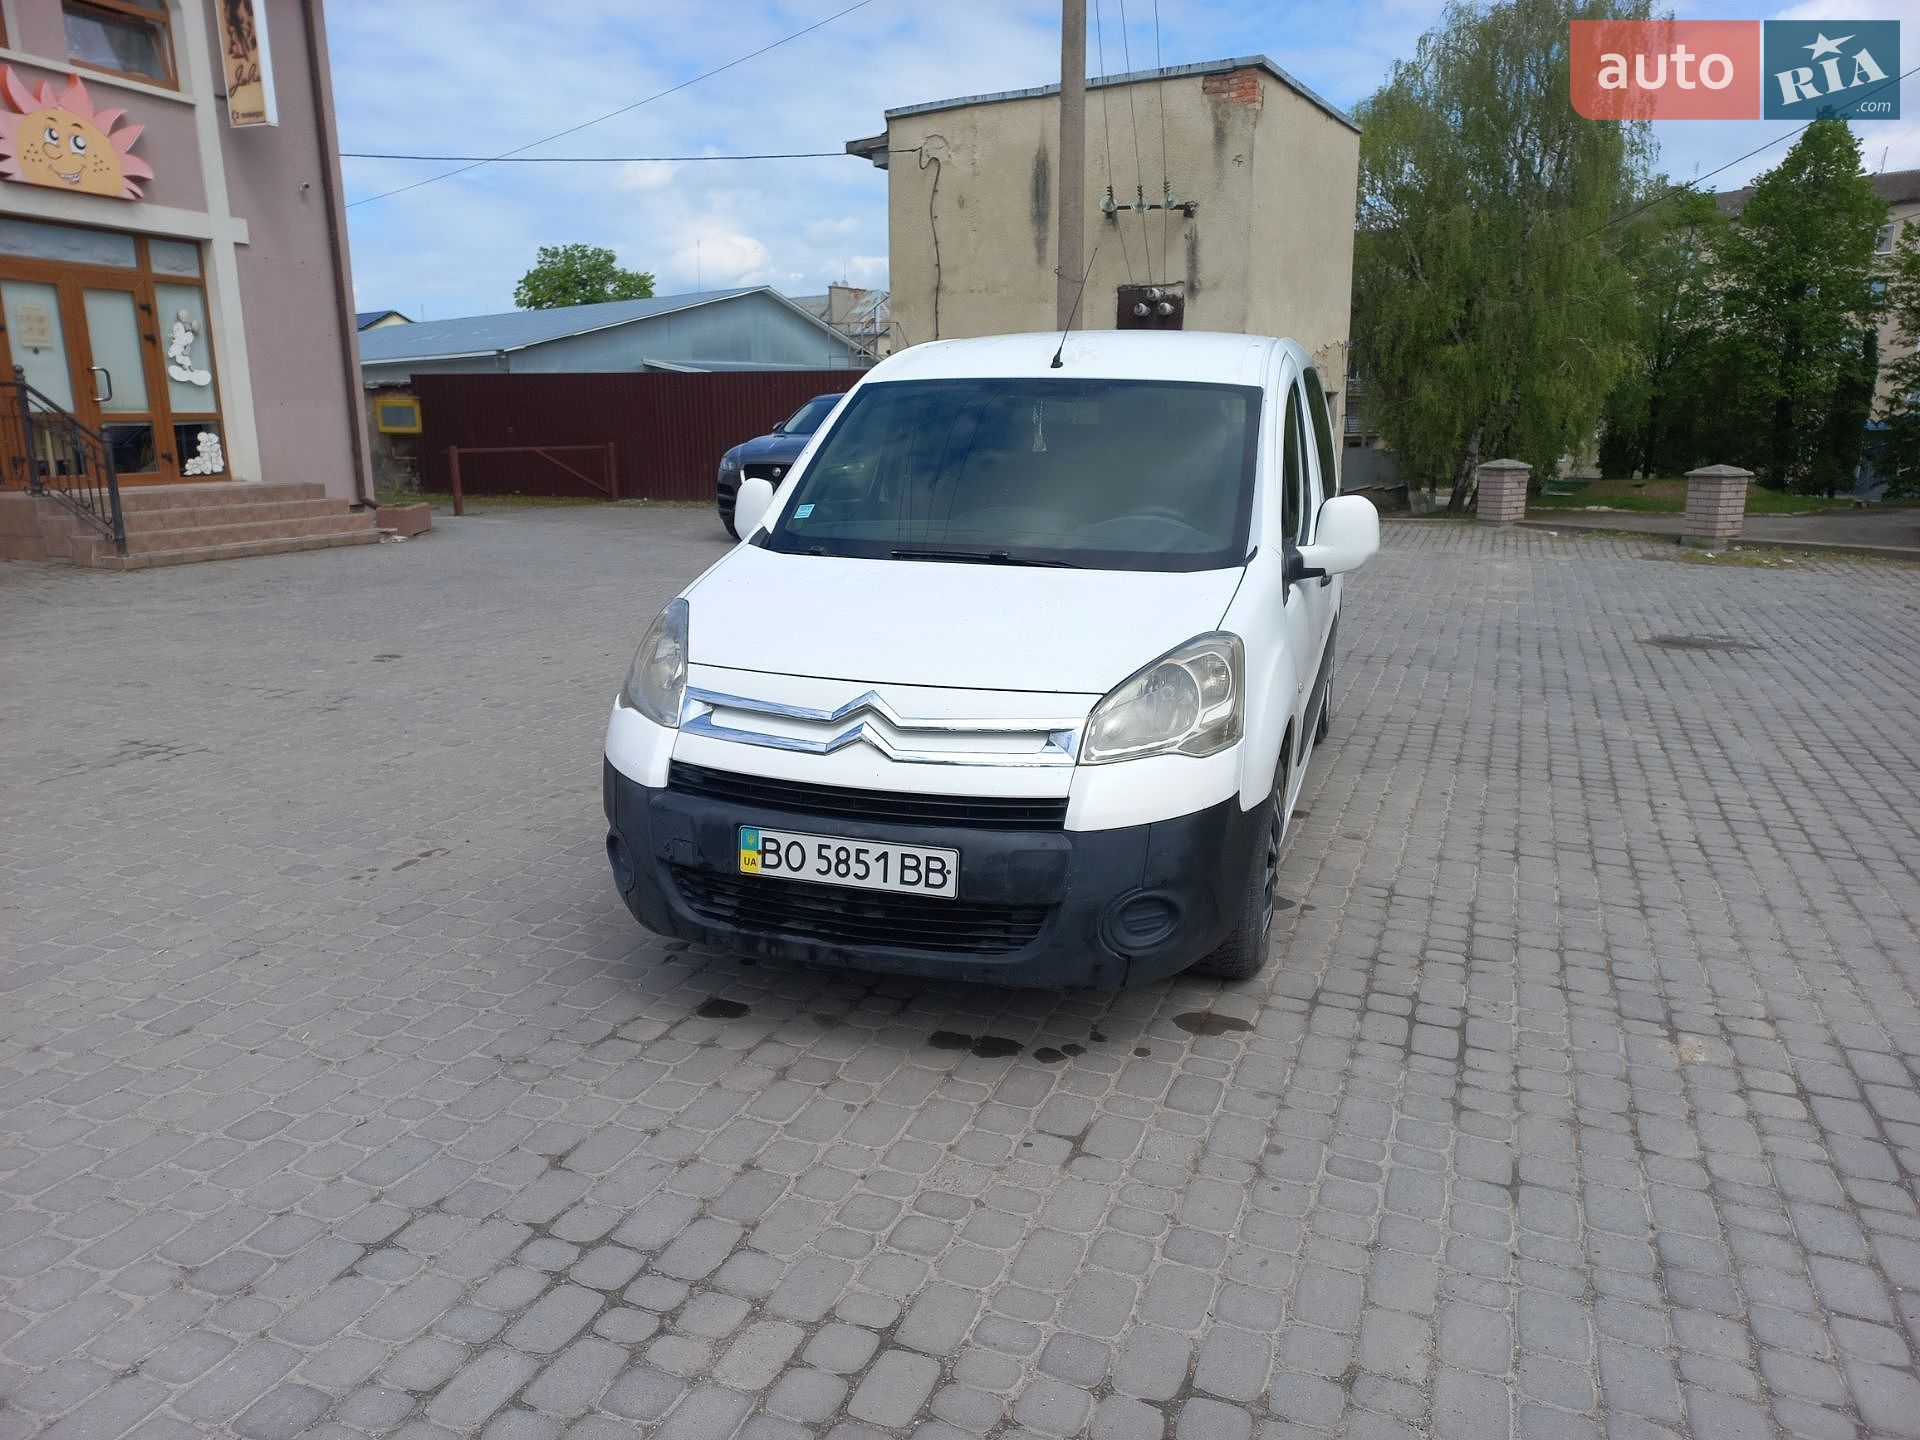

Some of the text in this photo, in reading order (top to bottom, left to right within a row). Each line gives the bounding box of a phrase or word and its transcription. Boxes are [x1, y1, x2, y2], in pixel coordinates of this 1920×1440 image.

[743, 856, 757, 866] UA
[761, 837, 947, 889] BO 5851 BB
